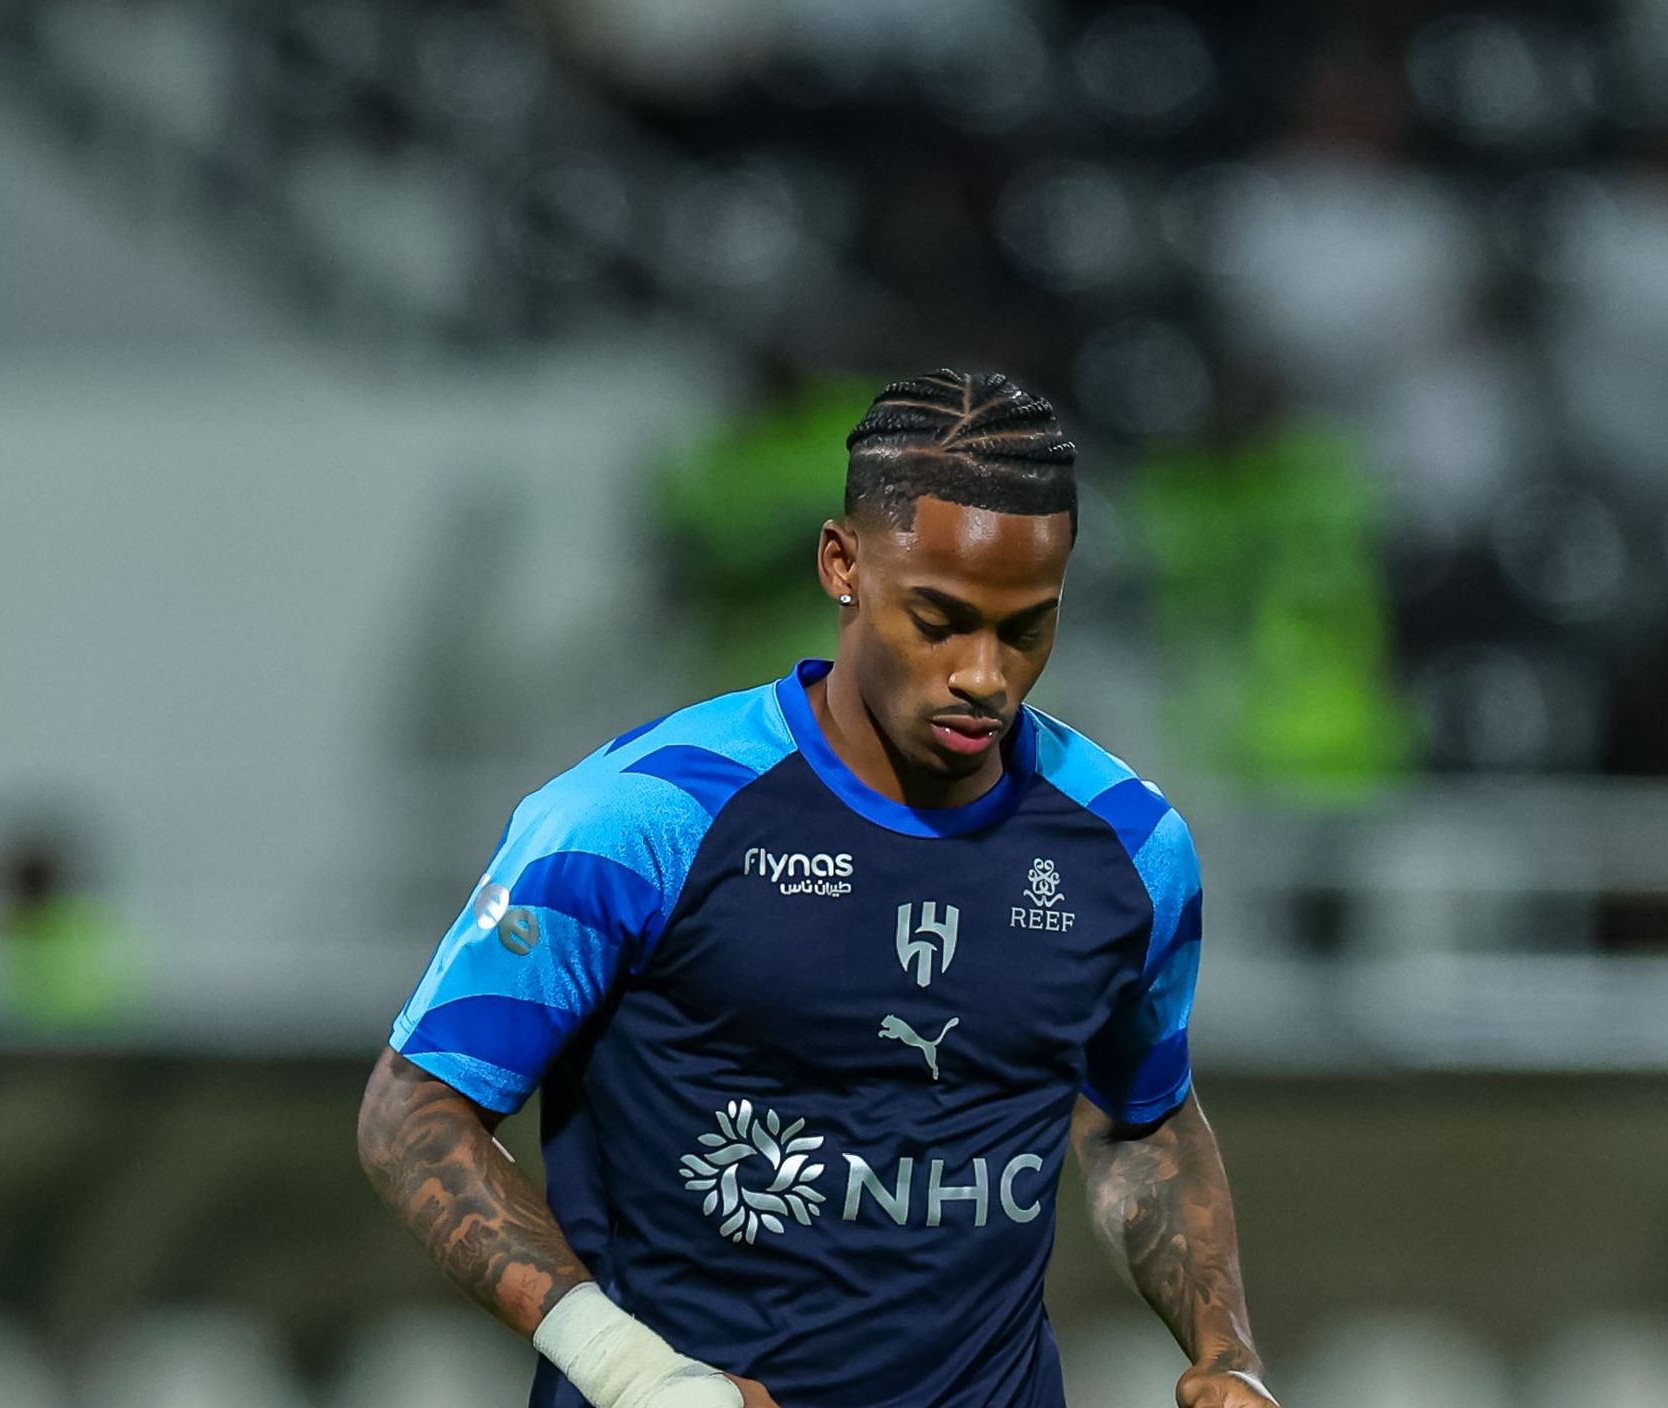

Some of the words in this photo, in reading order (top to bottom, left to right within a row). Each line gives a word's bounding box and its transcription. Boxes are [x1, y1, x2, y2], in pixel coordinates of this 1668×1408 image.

[743, 847, 854, 882] flynas
[779, 879, 812, 895] ناس
[814, 879, 852, 898] طيران
[1009, 906, 1076, 932] REEF
[841, 1152, 1044, 1227] NHC
